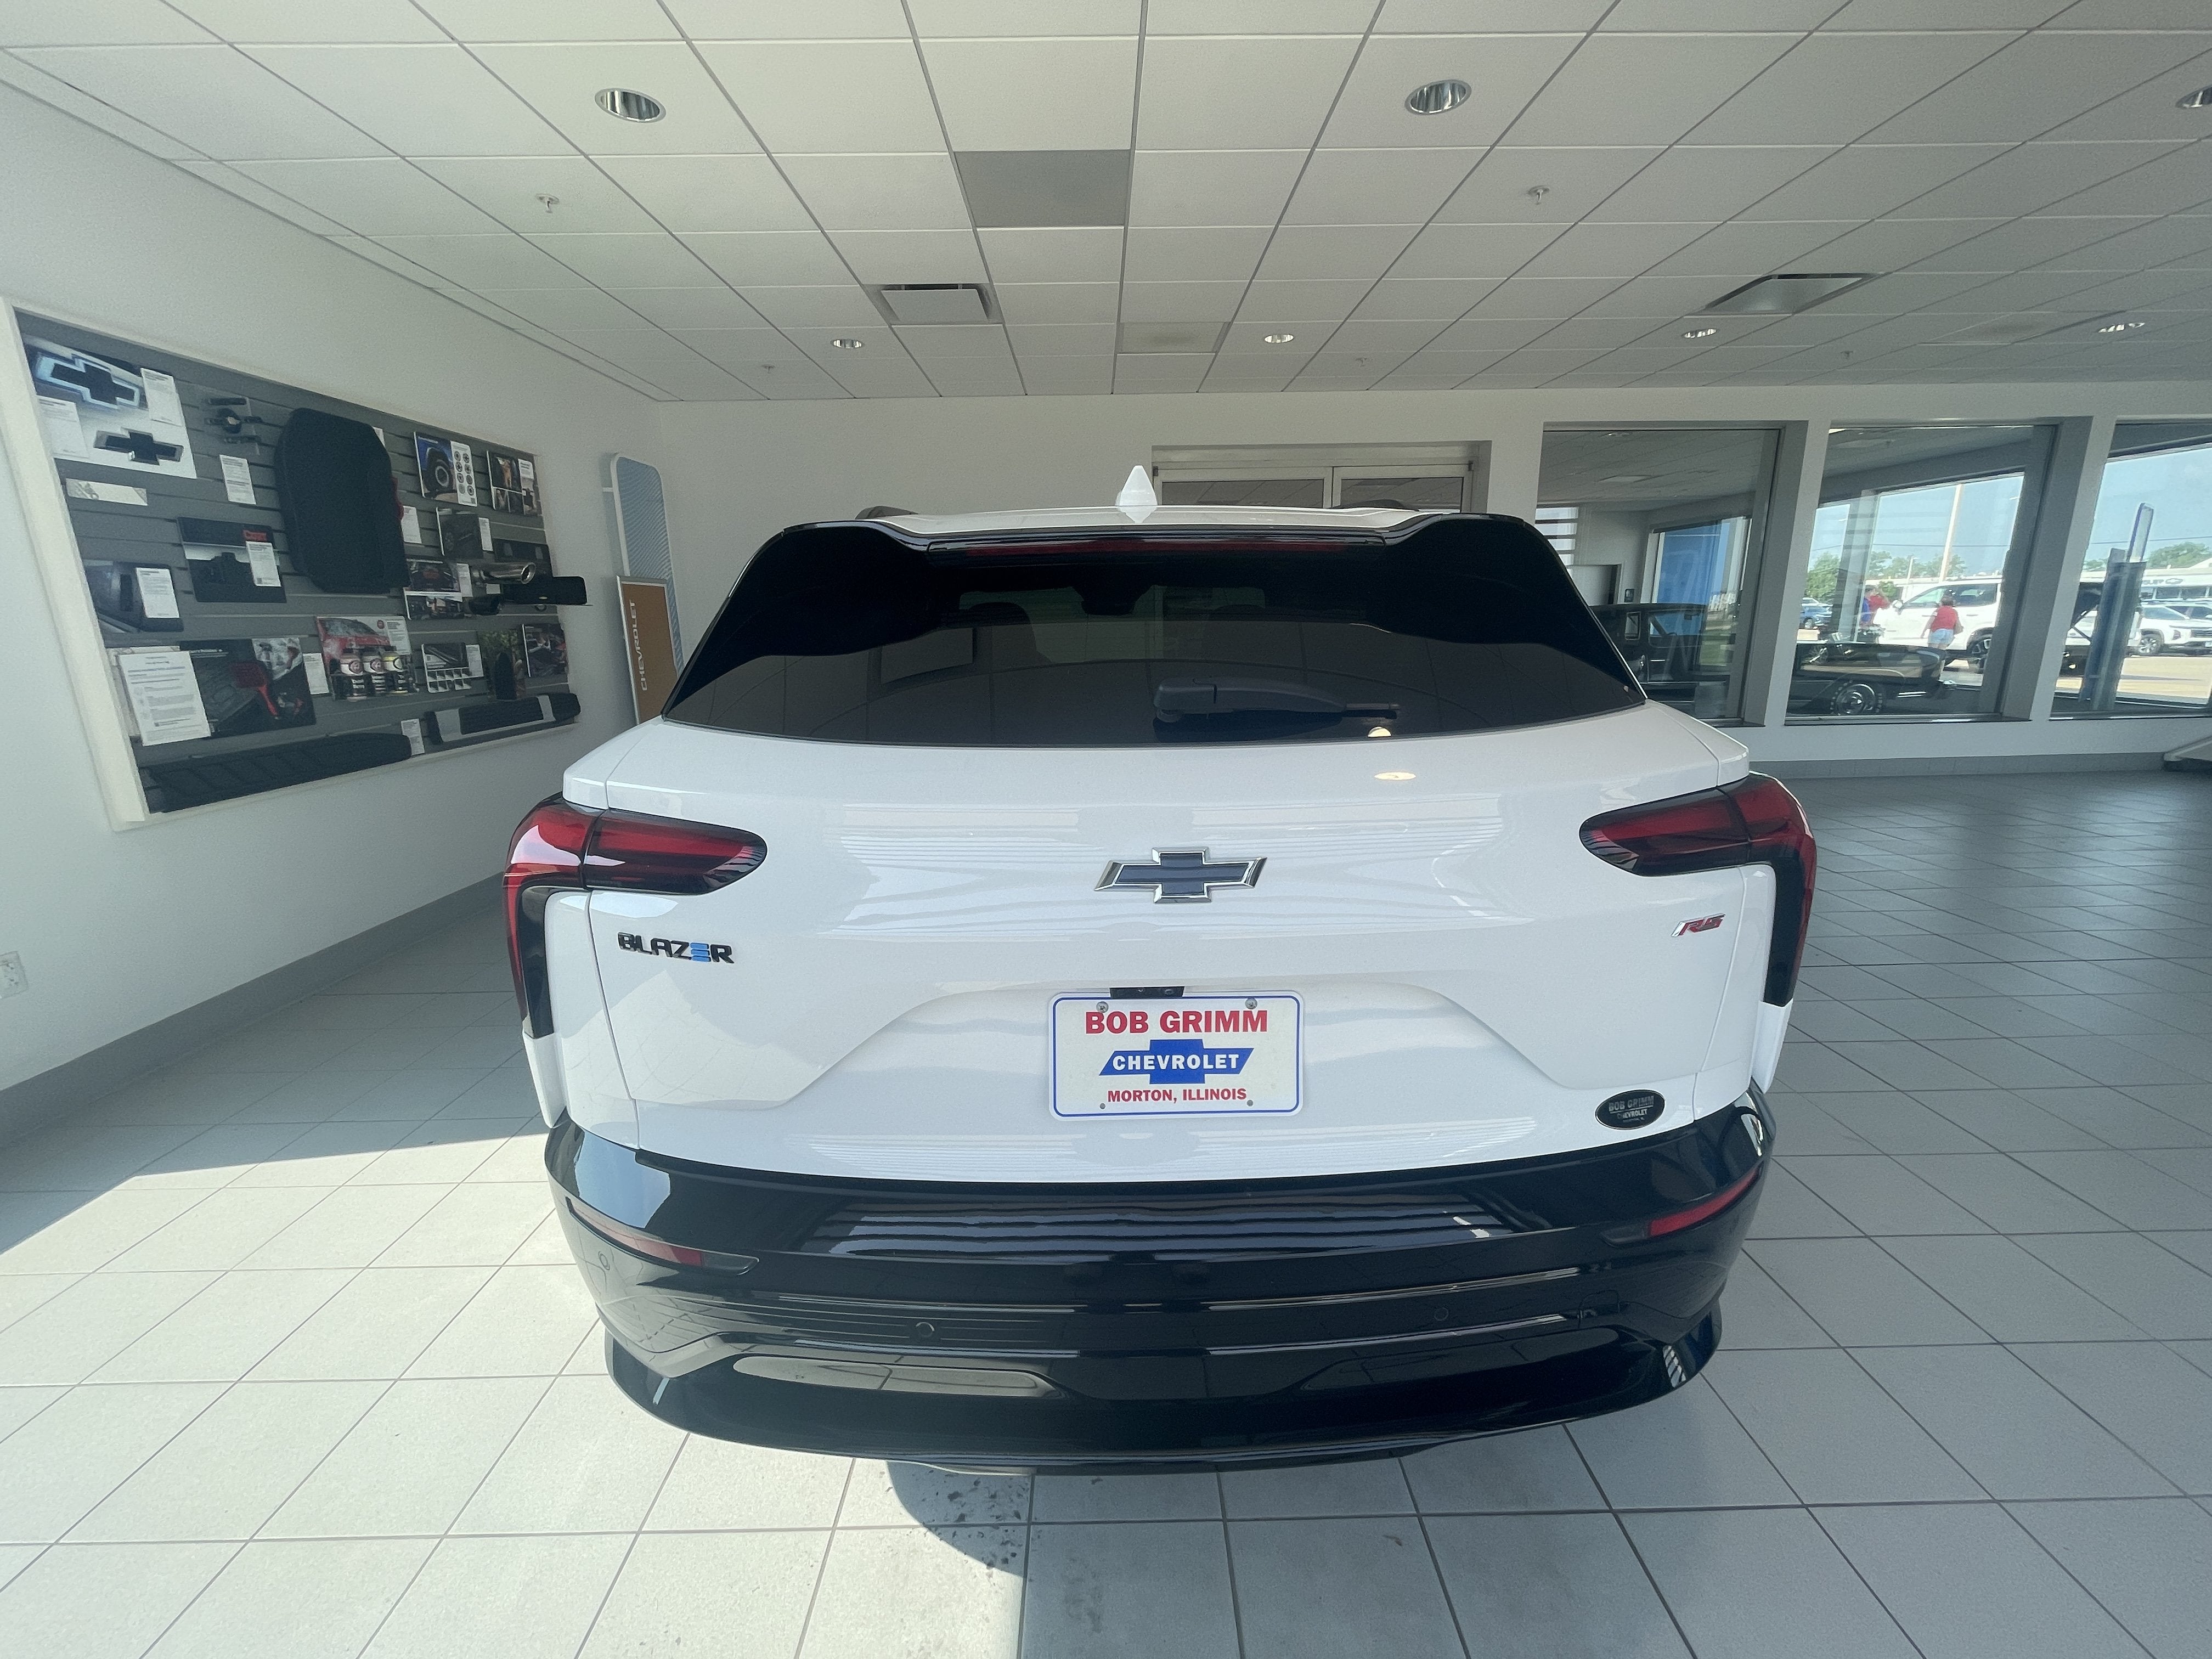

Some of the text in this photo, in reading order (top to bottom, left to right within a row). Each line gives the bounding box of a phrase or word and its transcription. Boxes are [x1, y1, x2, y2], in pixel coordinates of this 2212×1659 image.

[629, 600, 647, 691] CHEVROLET
[618, 932, 735, 964] BLAZER
[1085, 1010, 1268, 1034] BOB GRIMM
[1113, 1054, 1240, 1071] CHEVROLET
[1107, 1088, 1247, 1104] MORTON, ILLINOIS
[1609, 1101, 1625, 1111] BOB
